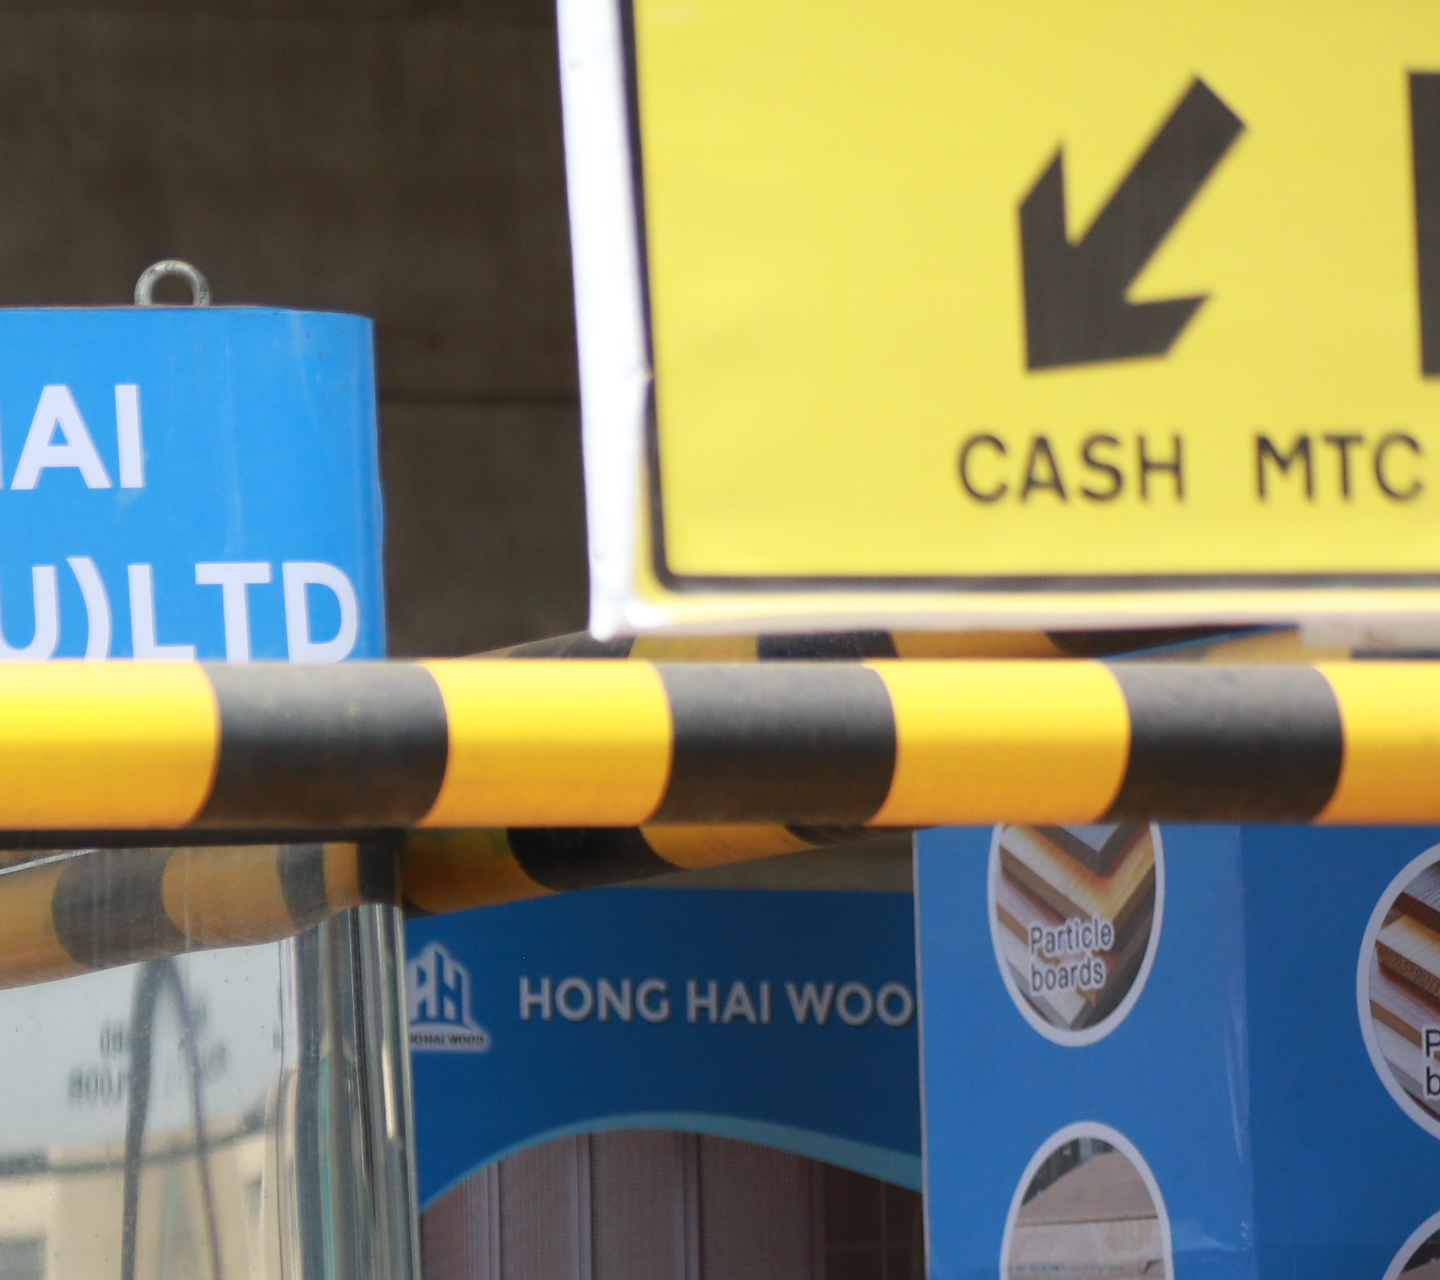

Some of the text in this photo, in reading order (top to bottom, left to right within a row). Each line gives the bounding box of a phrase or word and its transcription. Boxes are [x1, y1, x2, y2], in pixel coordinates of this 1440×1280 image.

[957, 432, 1425, 505] CASH MTC
[1029, 918, 1113, 954] Particle
[1030, 958, 1105, 993] boards
[519, 975, 670, 1023] HONG
[687, 979, 772, 1025] HAI
